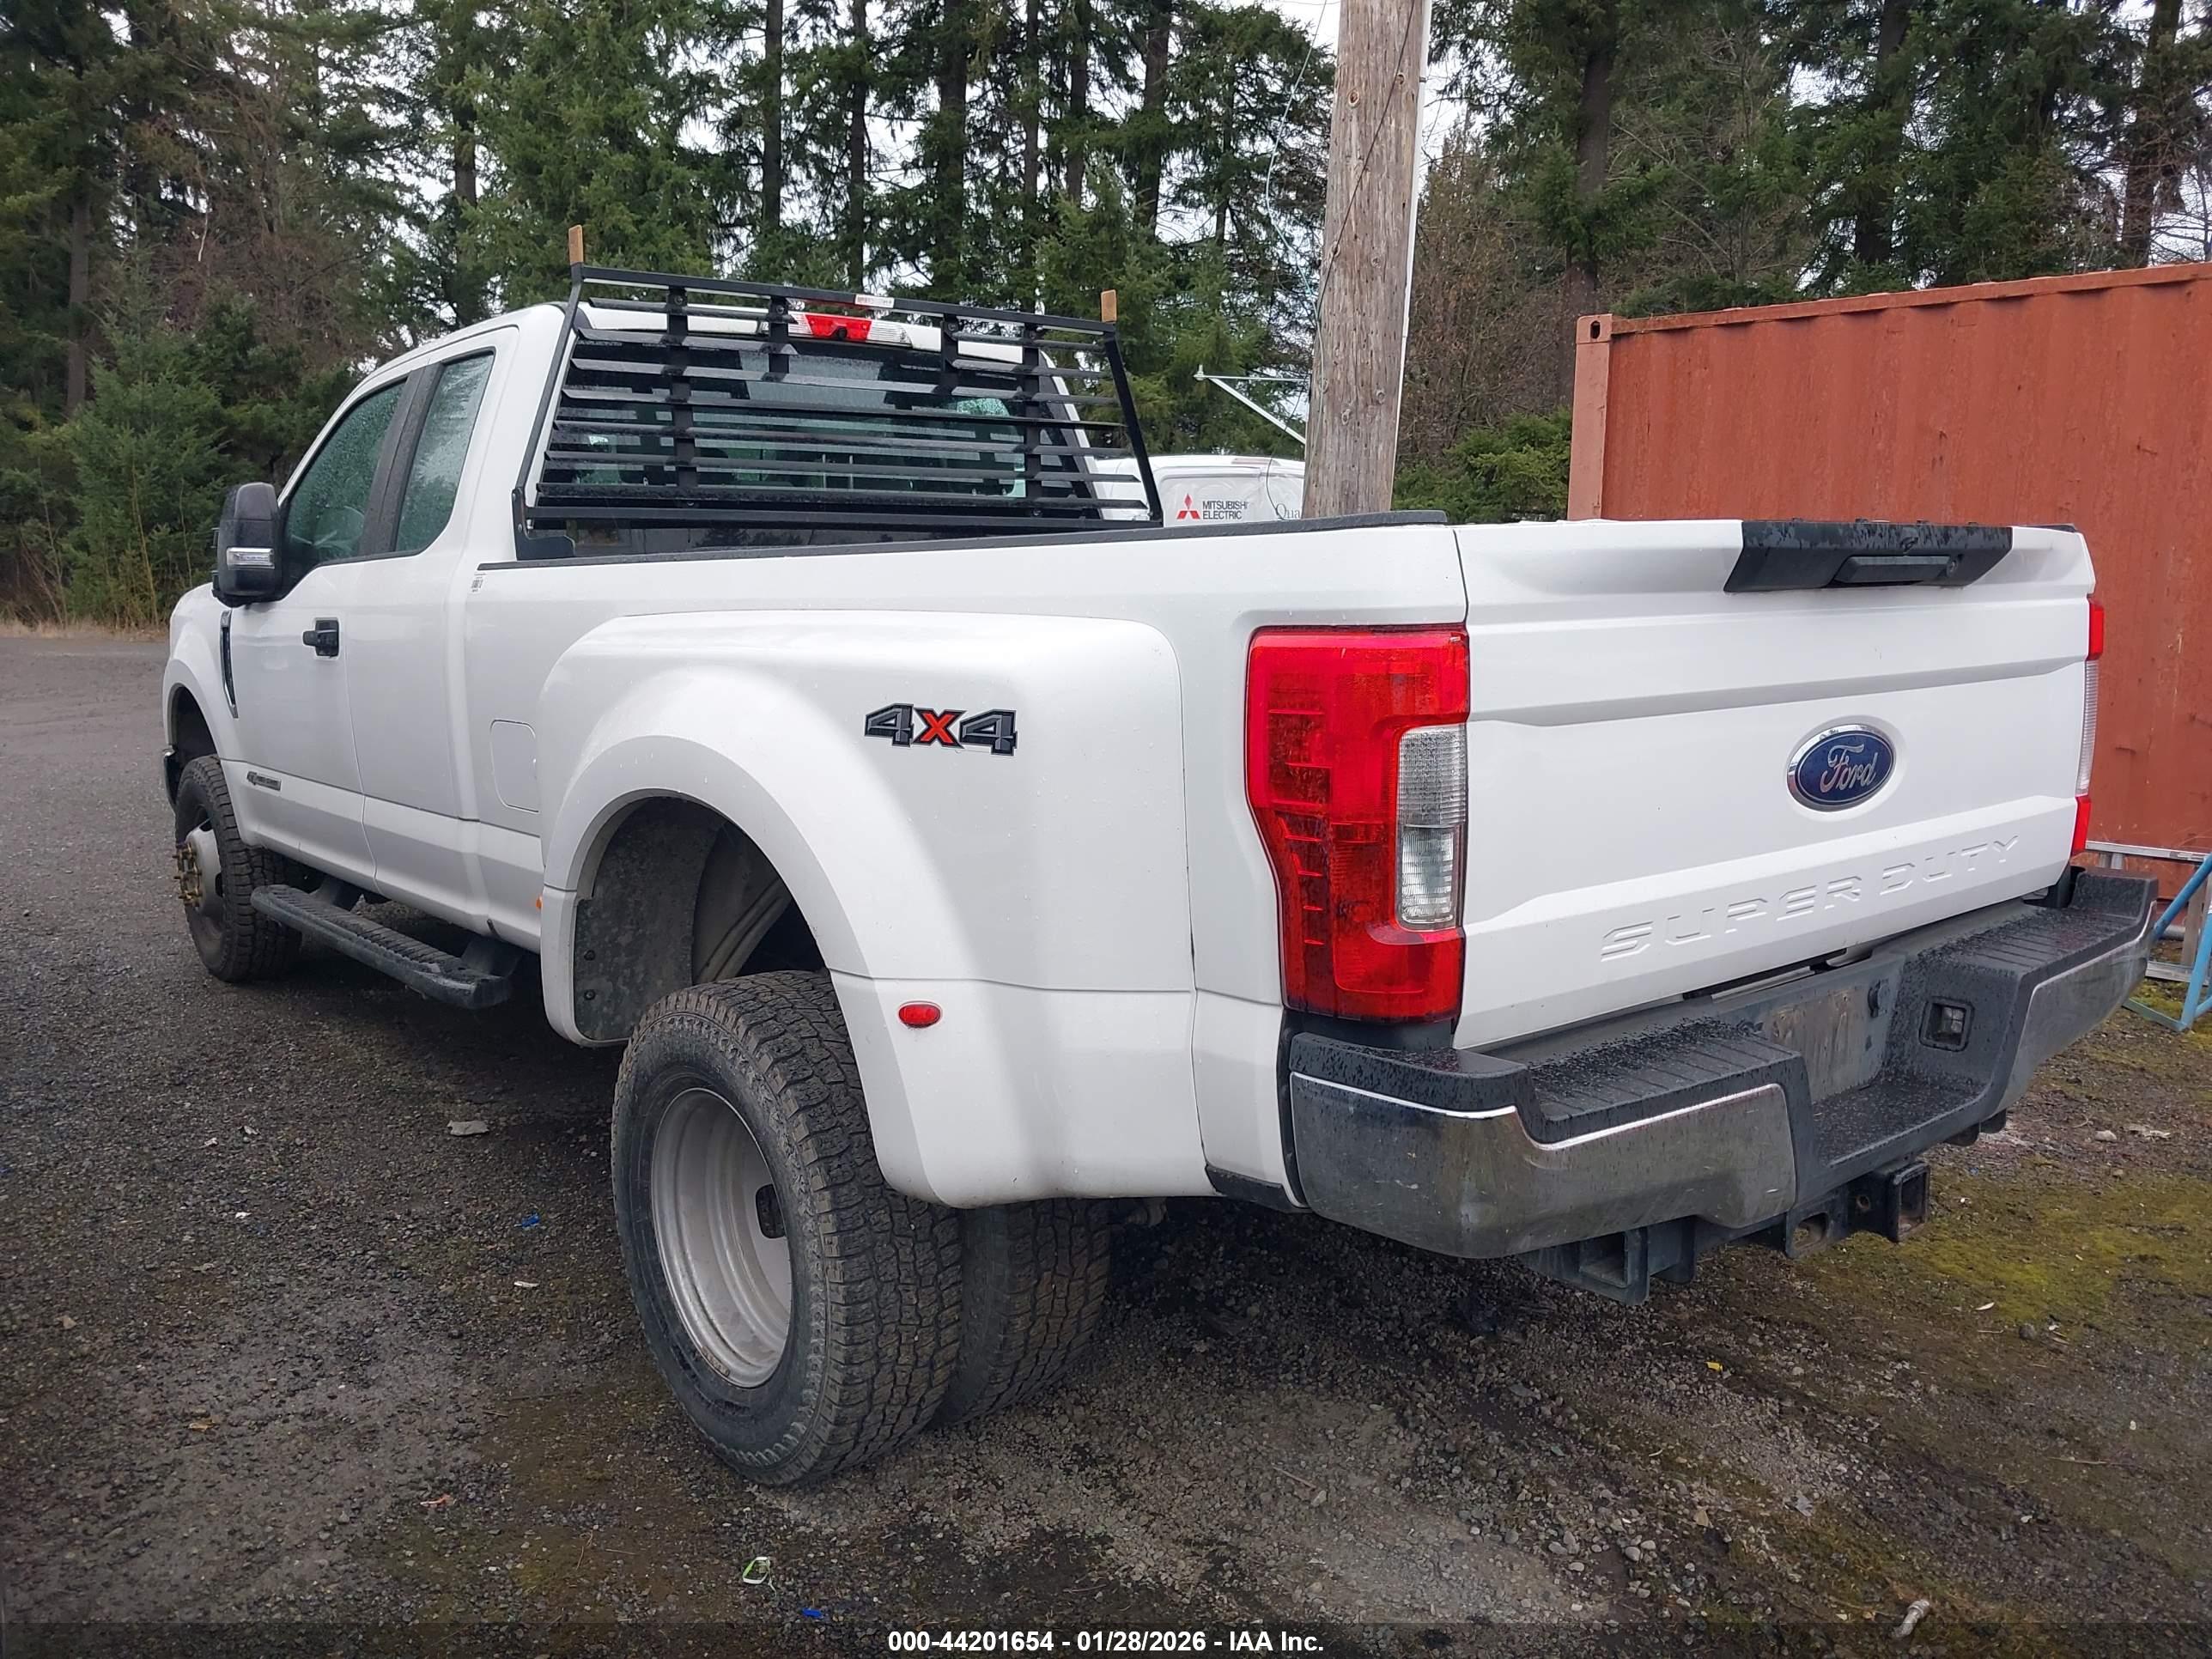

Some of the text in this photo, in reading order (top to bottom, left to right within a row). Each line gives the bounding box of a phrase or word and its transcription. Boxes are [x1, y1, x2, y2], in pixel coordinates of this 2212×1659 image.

[1202, 500, 1248, 510] MITSUBISHI
[1202, 510, 1243, 520] ELECTRIC
[1820, 744, 1878, 793] Ford
[1601, 835, 2019, 962] SUPER DUTY
